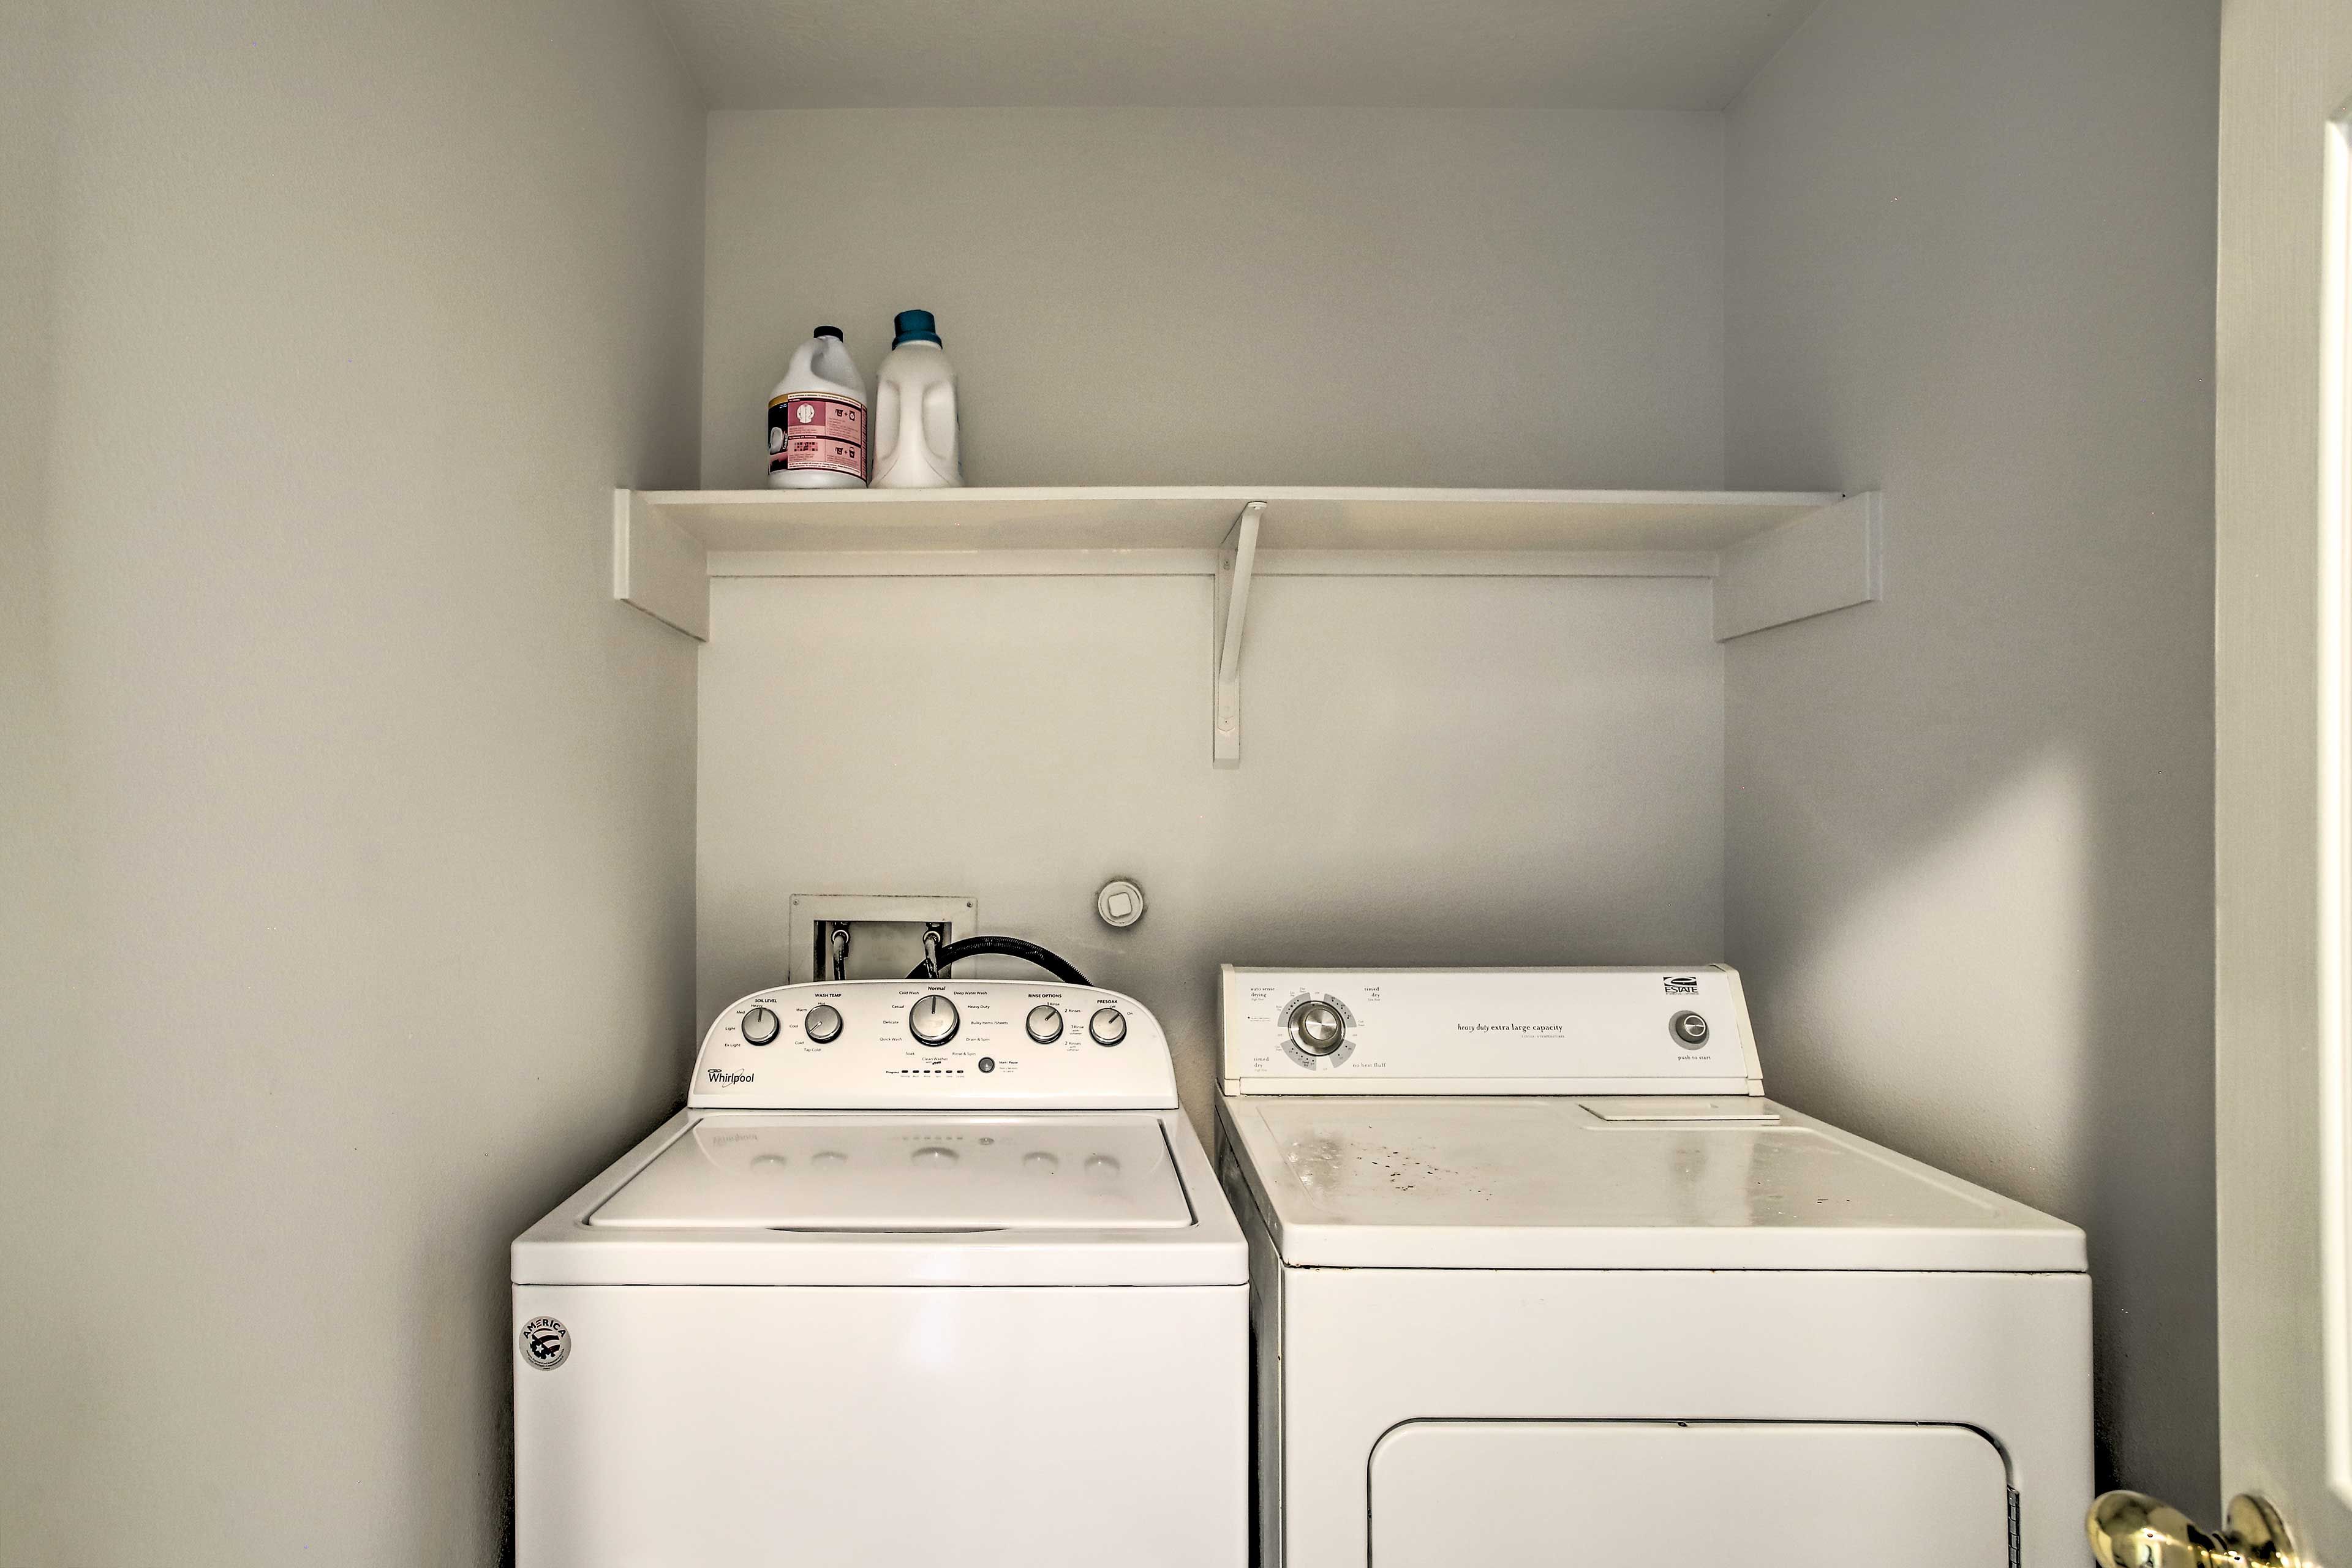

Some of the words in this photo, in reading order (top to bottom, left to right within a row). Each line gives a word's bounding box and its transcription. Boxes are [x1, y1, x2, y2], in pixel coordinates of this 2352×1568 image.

[1458, 1023, 1474, 1033] heavy
[1476, 1023, 1489, 1033] duty
[1511, 1023, 1530, 1033] large
[1532, 1024, 1562, 1033] capacity
[709, 1073, 754, 1085] Whirlpool
[523, 1319, 566, 1339] AMERICA
